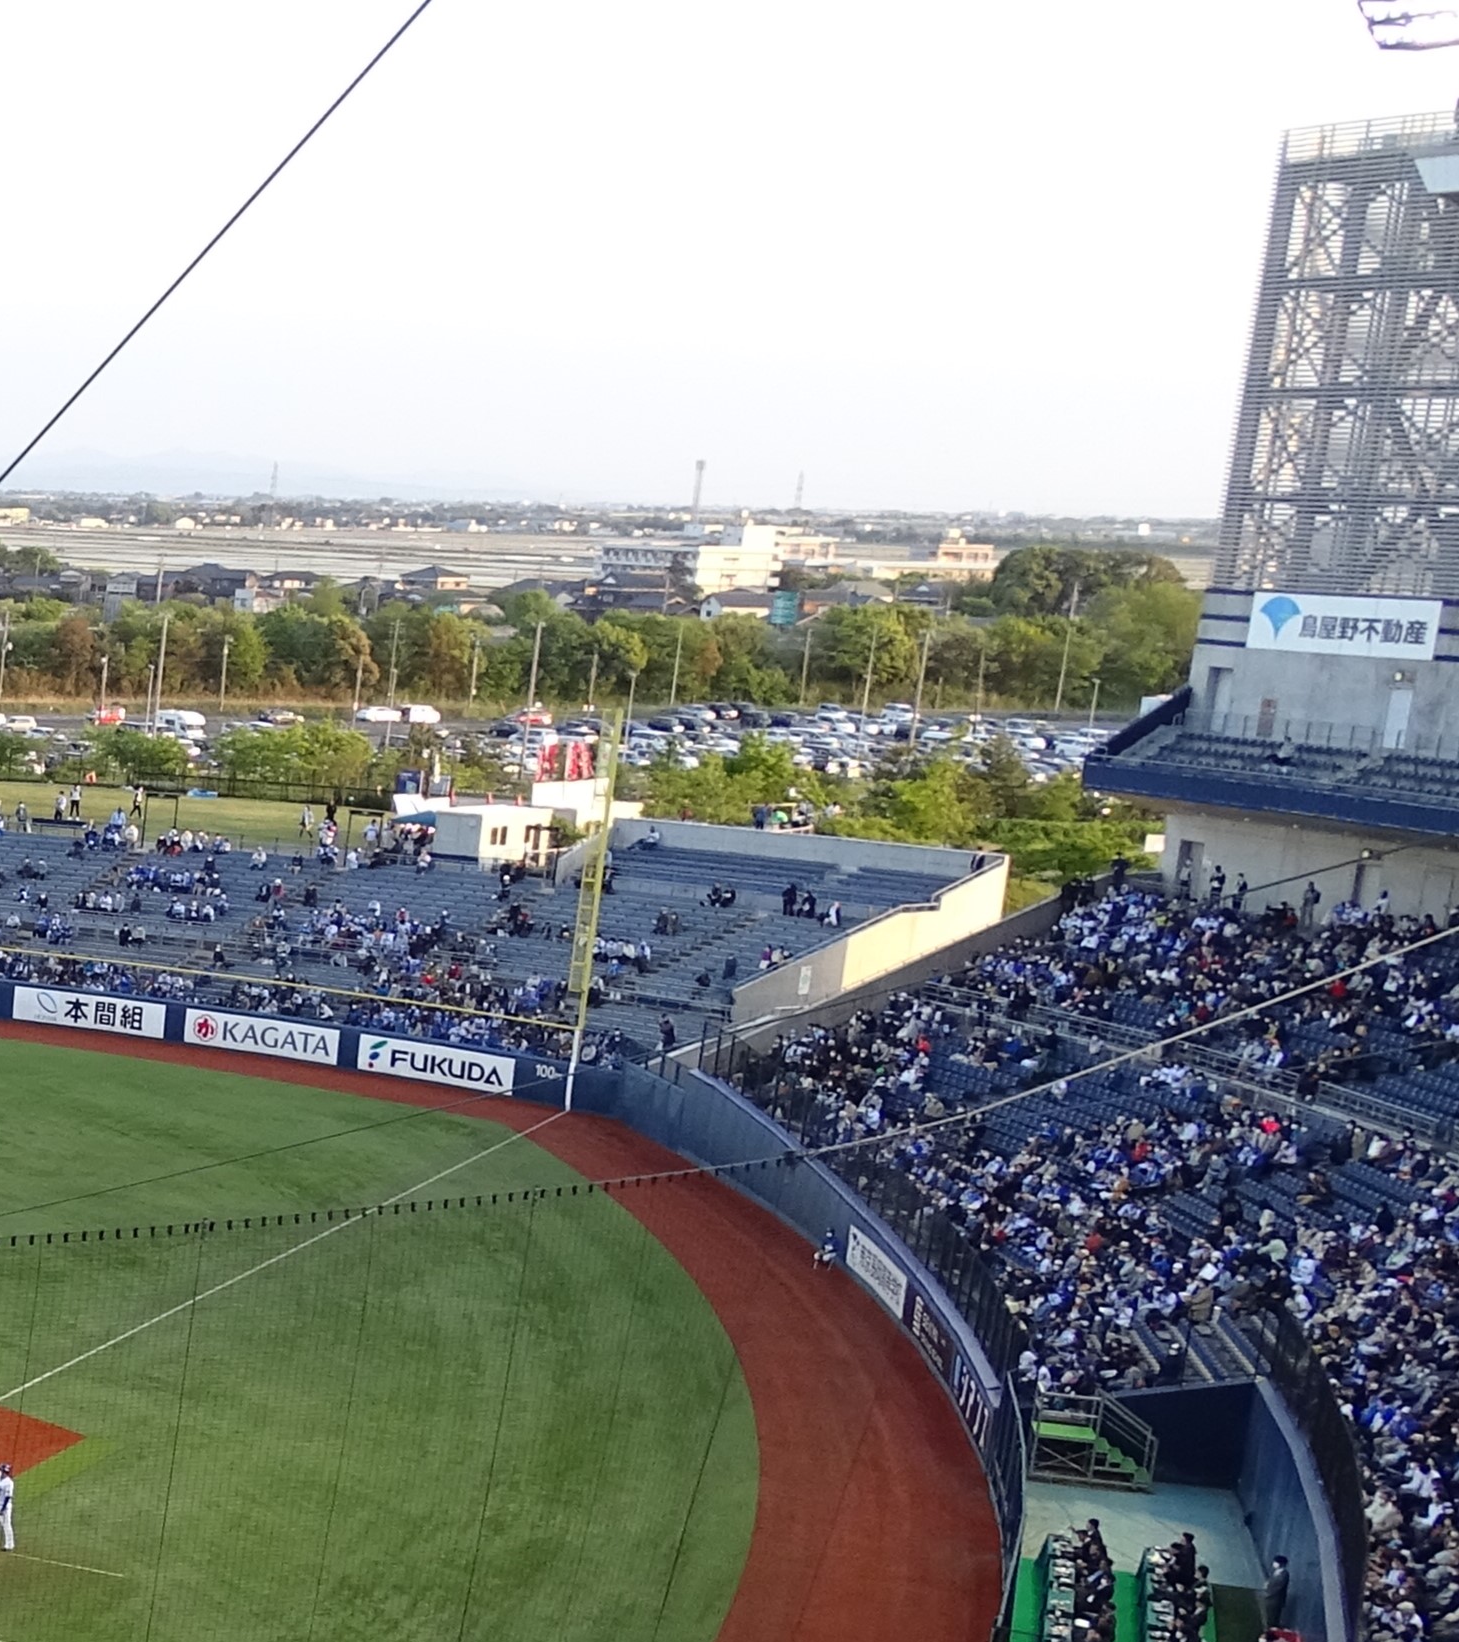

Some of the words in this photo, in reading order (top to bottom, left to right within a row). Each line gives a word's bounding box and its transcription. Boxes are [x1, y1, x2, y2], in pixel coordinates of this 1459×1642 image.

[1299, 614, 1428, 645] 鳥屋野不動産
[64, 998, 144, 1031] 本間組
[222, 1021, 330, 1057] KAGATA
[390, 1049, 504, 1087] FUKUDA
